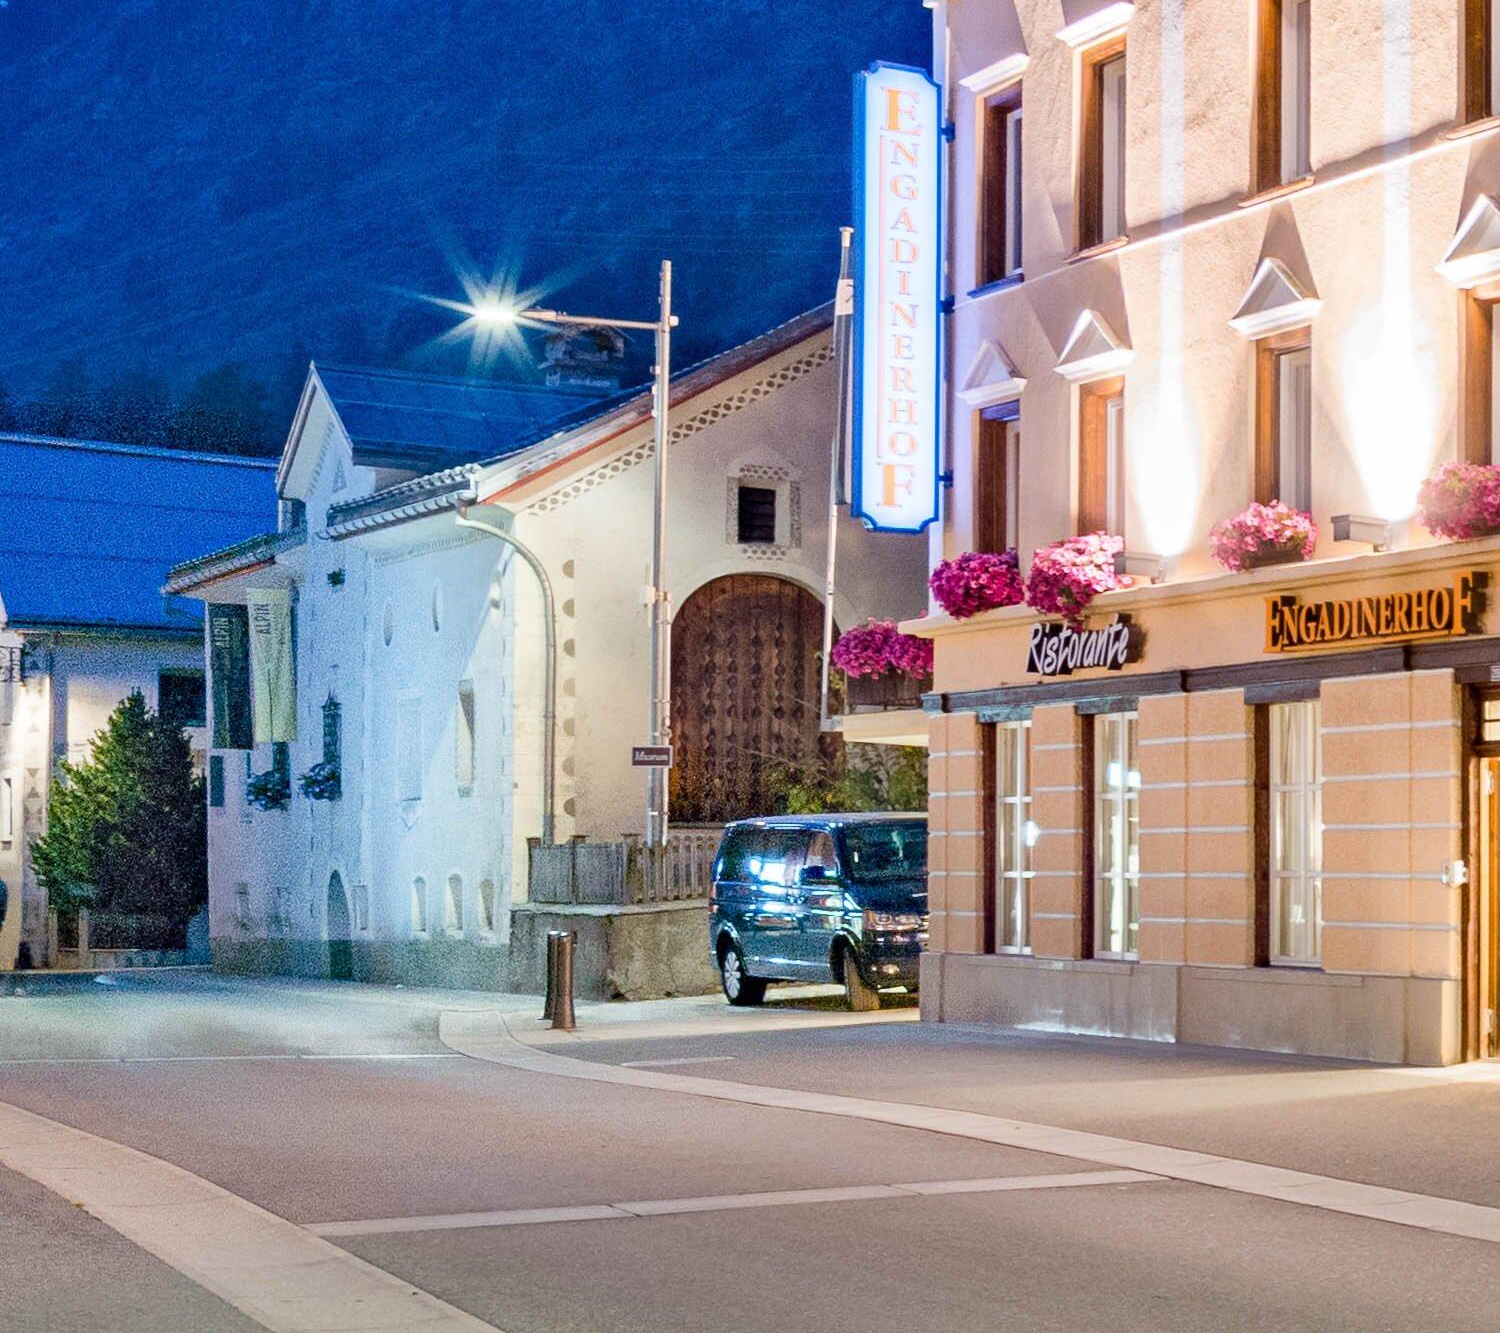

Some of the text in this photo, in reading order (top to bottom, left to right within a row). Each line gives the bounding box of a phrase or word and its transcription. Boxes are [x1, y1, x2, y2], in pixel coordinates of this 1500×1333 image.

[876, 85, 922, 509] ENGADINERHOF
[254, 602, 272, 634] ALPIN
[1025, 613, 1130, 675] Ristorante
[1262, 569, 1476, 654] ENGADINERHOF
